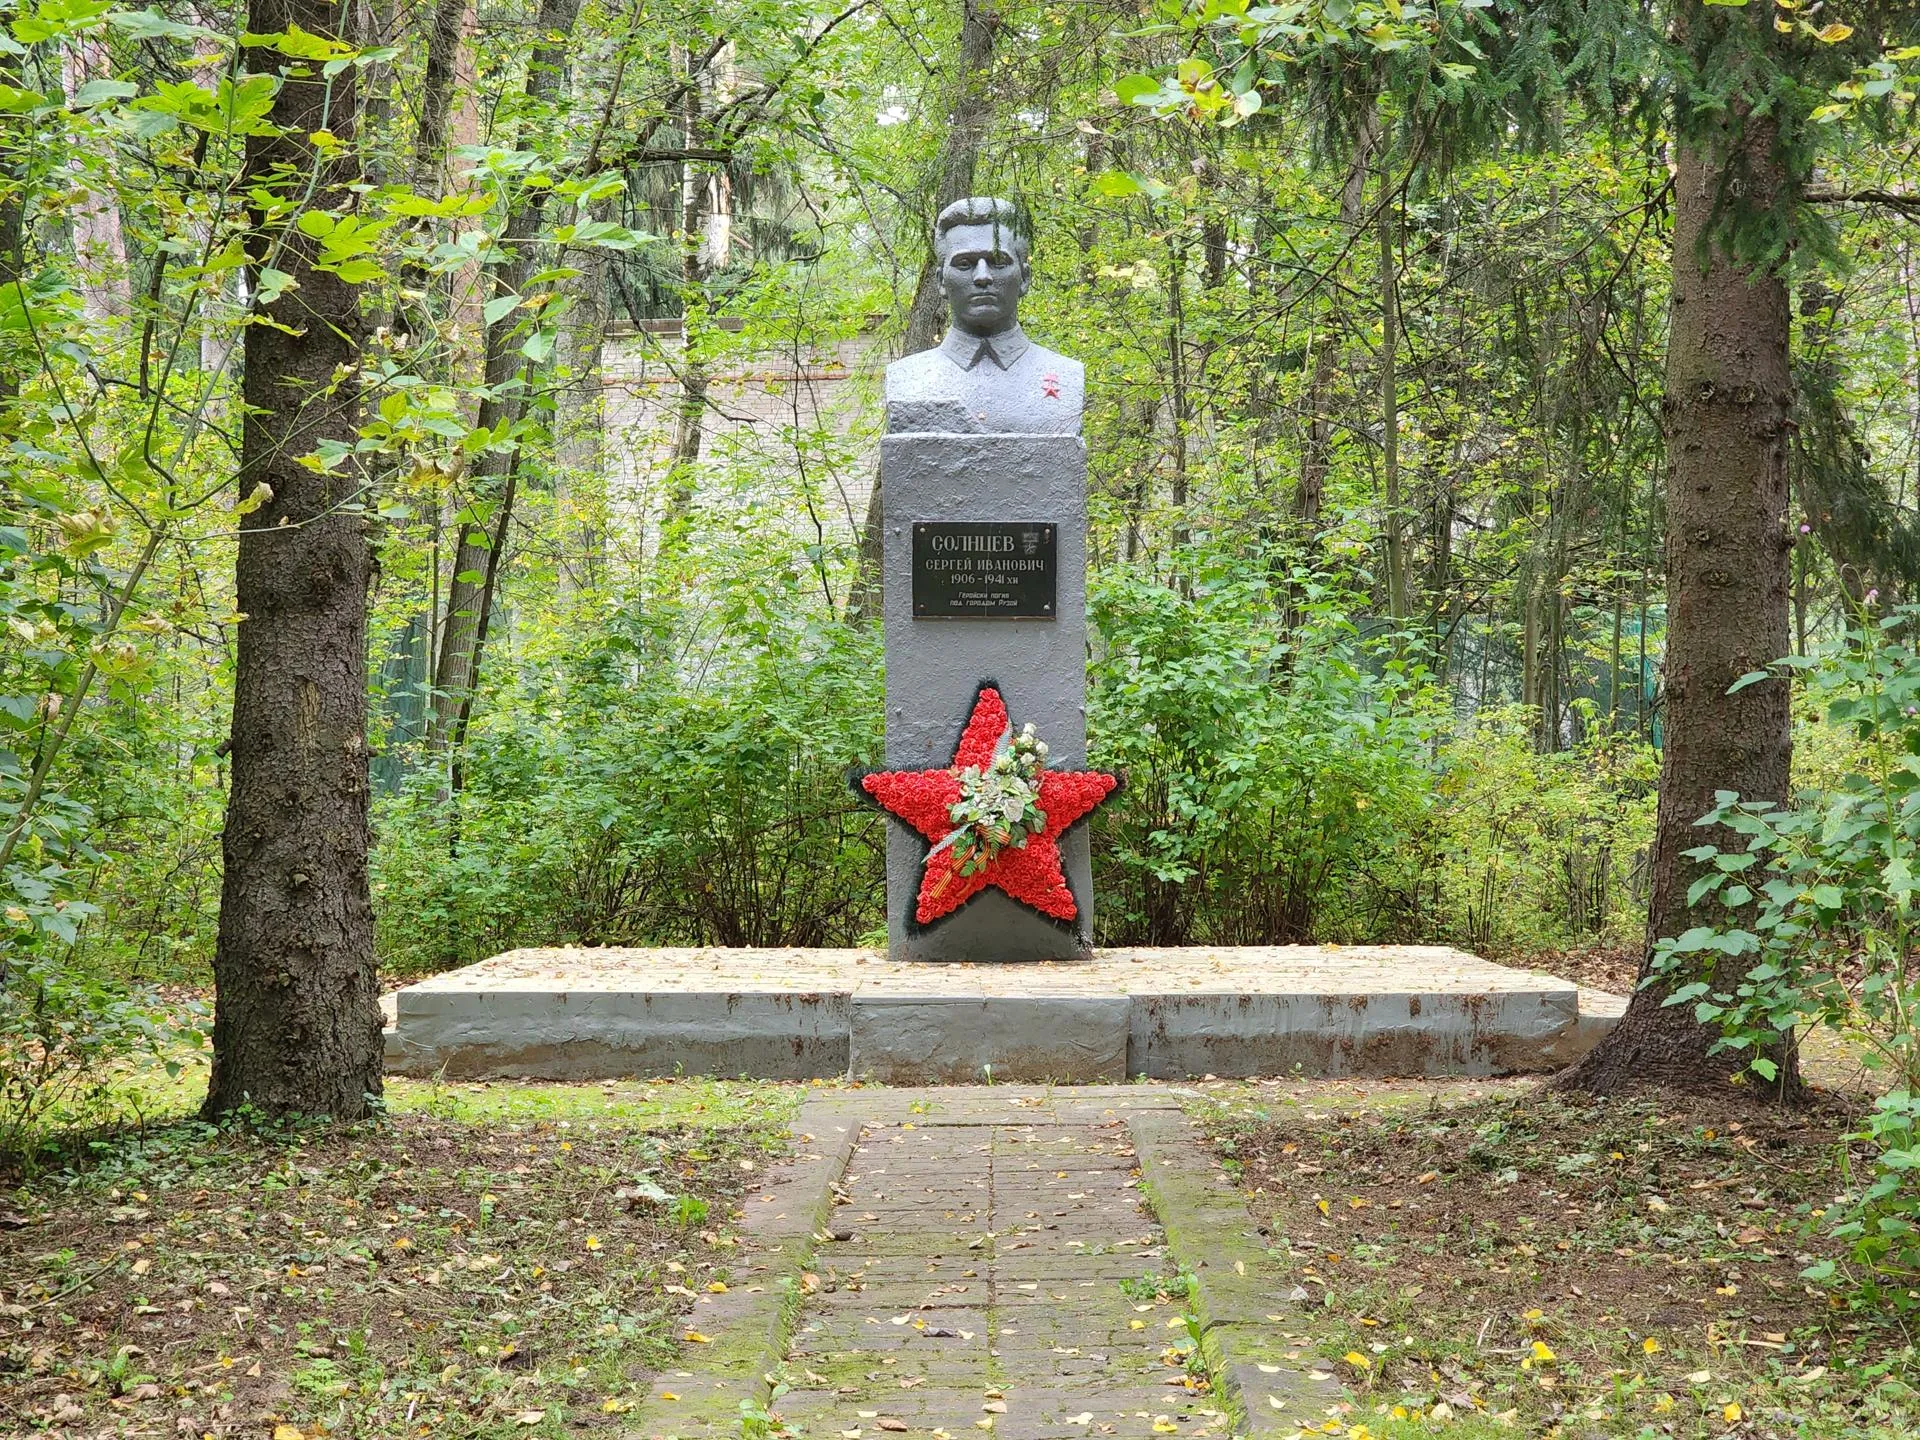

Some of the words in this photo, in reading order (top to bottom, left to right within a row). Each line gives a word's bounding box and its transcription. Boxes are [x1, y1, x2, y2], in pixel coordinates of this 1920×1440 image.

[932, 535, 1015, 552] СОЛНЦЕВ
[925, 558, 972, 571] СЕРГЕЙ
[977, 559, 1044, 571] ИВАНОВИЧ
